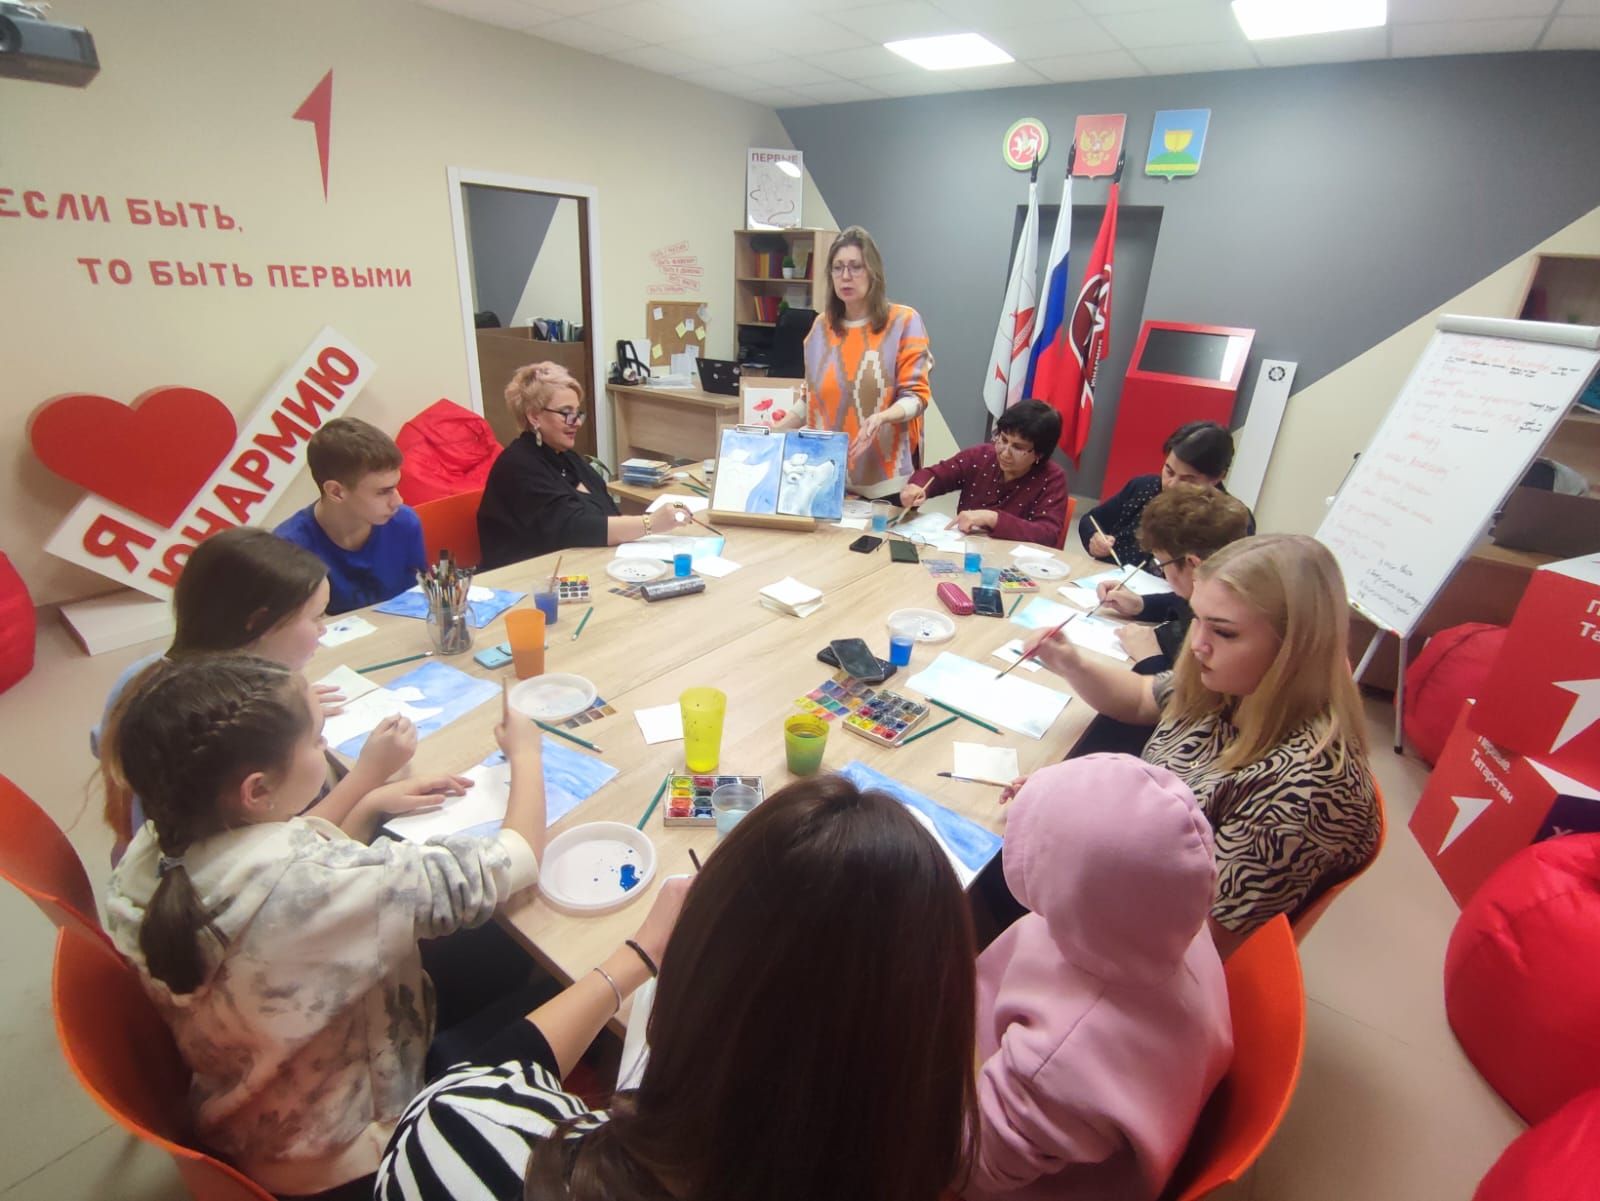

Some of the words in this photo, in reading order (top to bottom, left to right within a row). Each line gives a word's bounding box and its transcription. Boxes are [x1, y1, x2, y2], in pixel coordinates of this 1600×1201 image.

[0, 188, 110, 223] ЕСЛИ
[77, 258, 133, 285] ТО
[149, 260, 254, 288] БЫТЬ
[267, 264, 412, 288] ПЕРВЫМИ
[83, 513, 157, 573] Я
